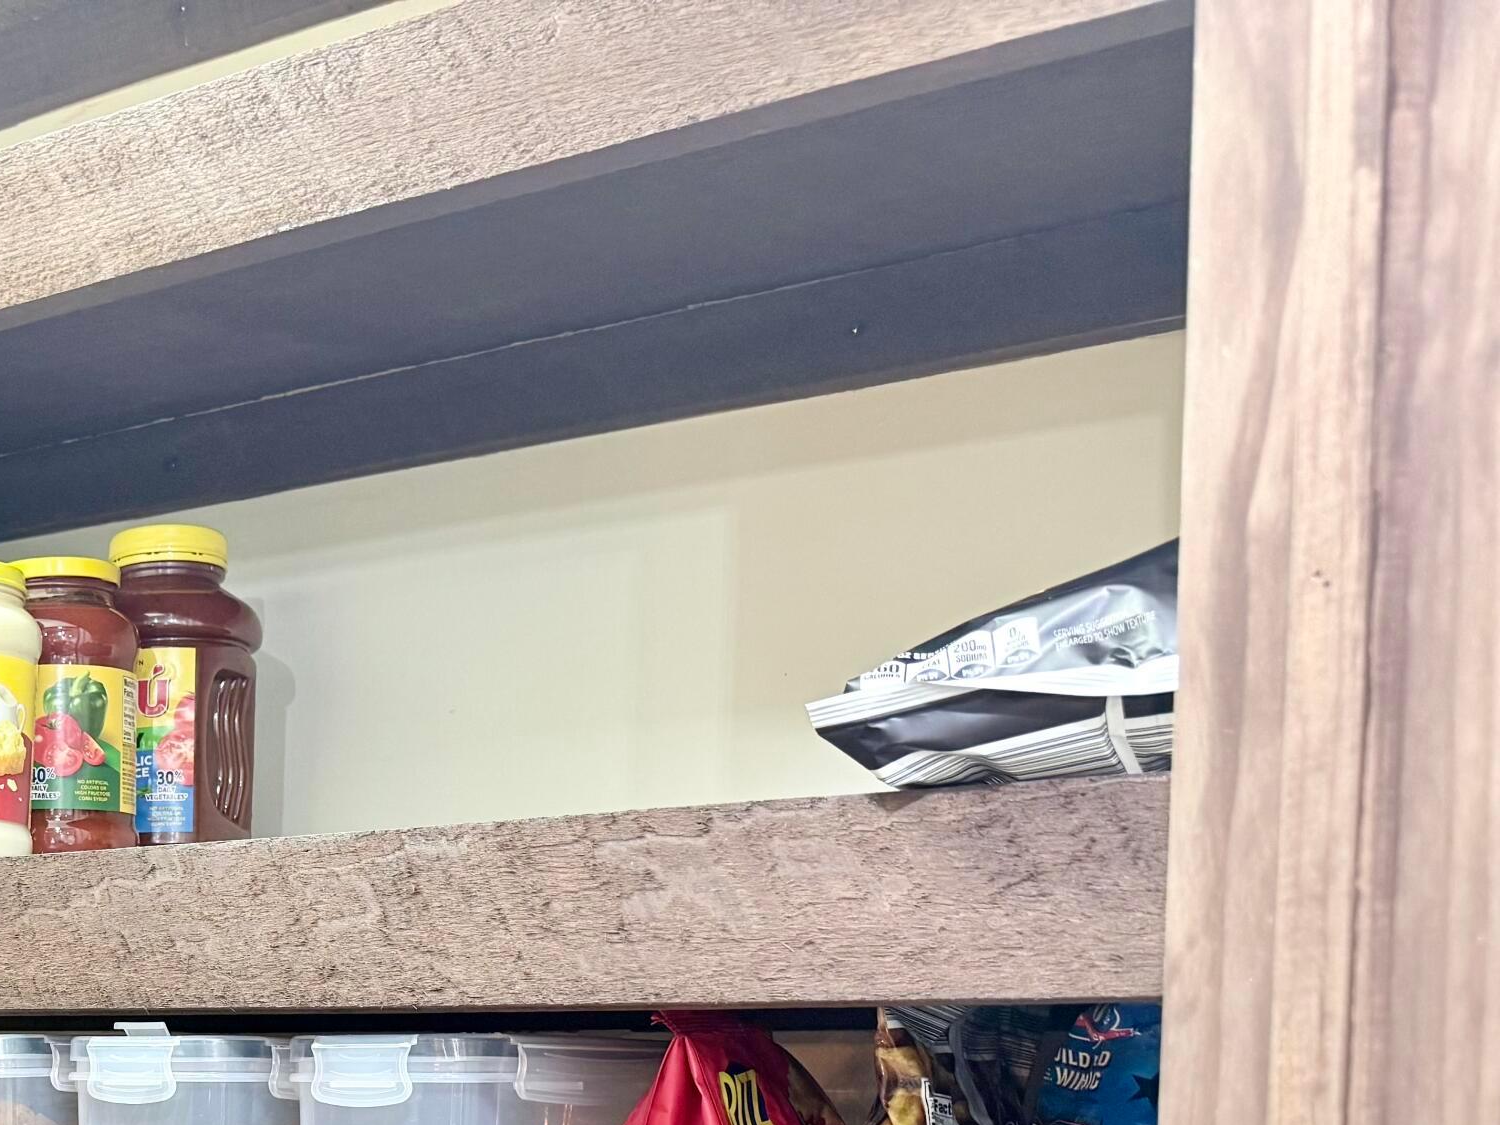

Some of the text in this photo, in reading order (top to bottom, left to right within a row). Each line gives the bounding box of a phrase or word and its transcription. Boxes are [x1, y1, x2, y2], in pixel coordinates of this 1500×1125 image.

[1053, 623, 1085, 638] SERVING
[1103, 624, 1126, 640] SHOW
[955, 652, 988, 664] SODIUM
[157, 770, 184, 786] 30%
